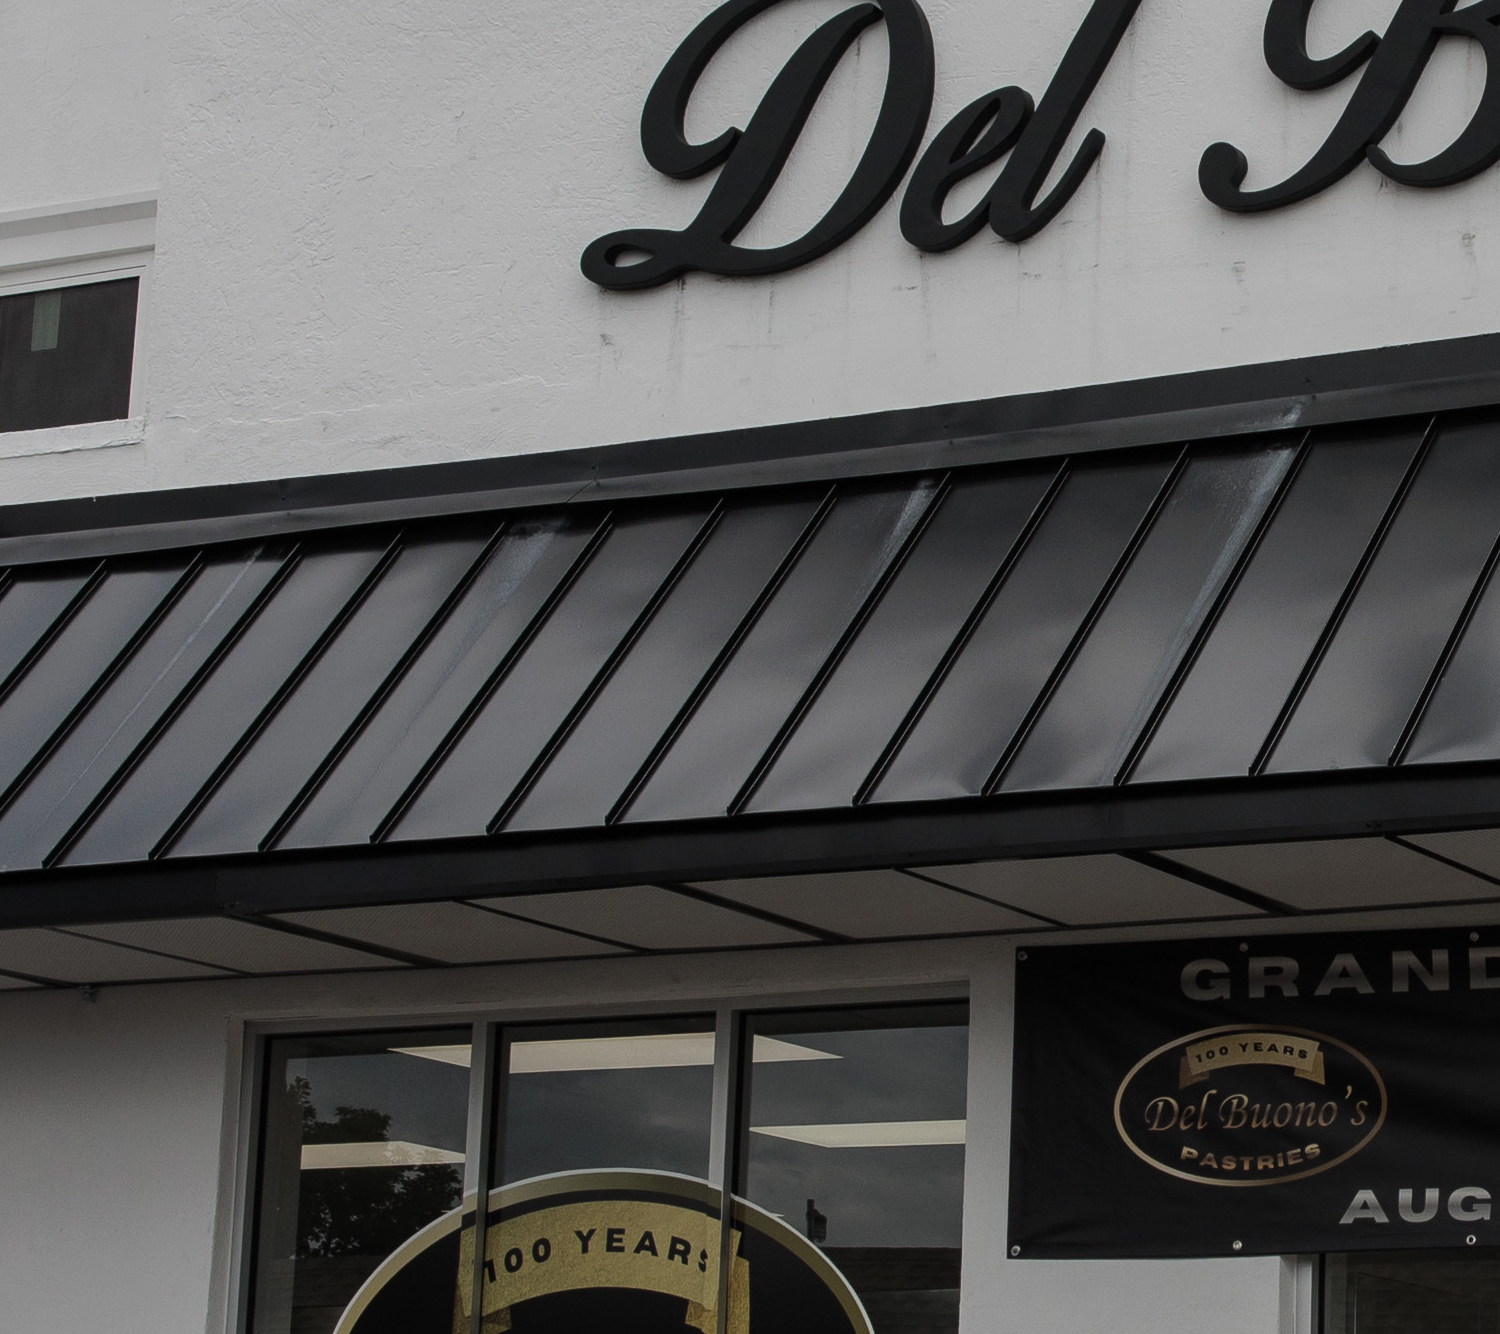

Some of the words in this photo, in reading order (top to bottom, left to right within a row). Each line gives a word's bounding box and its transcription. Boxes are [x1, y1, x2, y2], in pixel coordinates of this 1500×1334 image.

[1193, 1047, 1233, 1066] 100
[1241, 1042, 1311, 1064] YEARS
[1143, 1091, 1214, 1135] Del
[1216, 1083, 1369, 1137] Buono's
[1178, 1142, 1323, 1174] PASTRIES
[484, 1237, 553, 1285] 100
